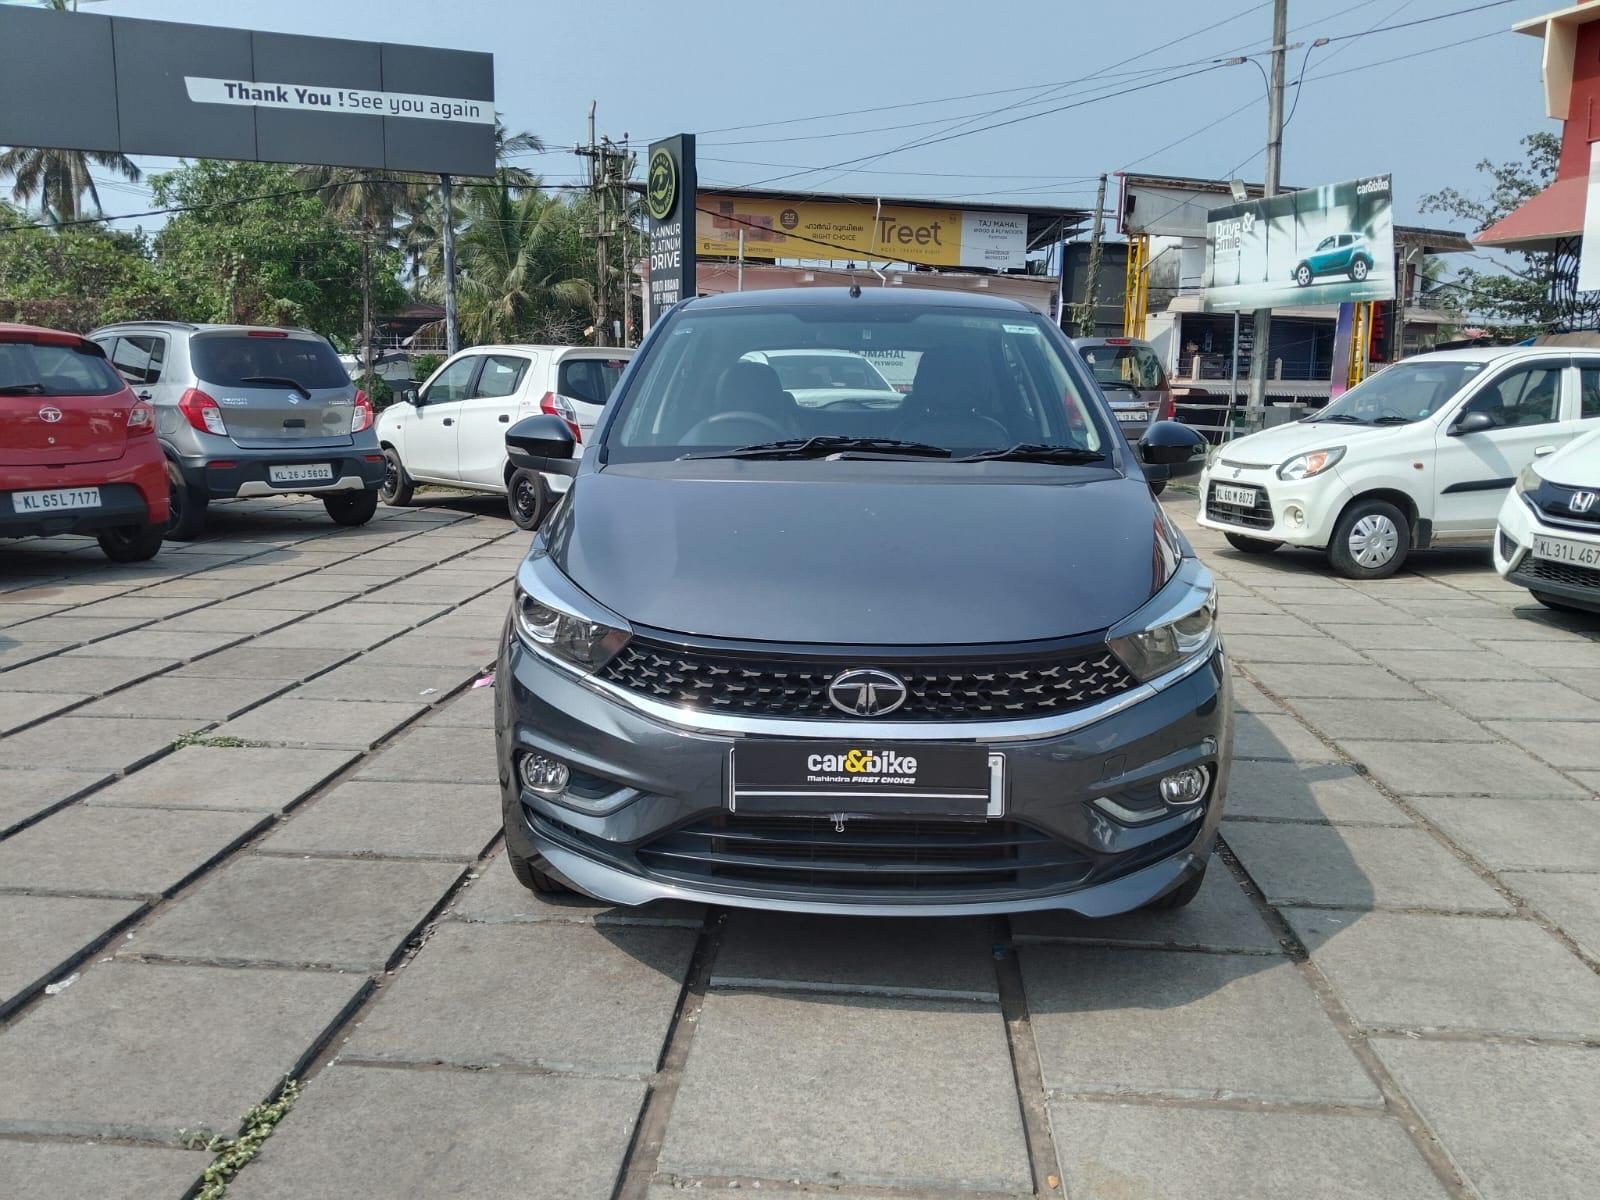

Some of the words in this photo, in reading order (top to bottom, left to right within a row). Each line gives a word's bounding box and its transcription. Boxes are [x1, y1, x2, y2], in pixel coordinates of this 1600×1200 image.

[224, 82, 288, 102] Thank
[294, 88, 331, 106] You
[349, 92, 382, 109] See
[389, 99, 423, 114] you
[430, 101, 480, 118] again
[1357, 179, 1389, 195] car&bike
[873, 216, 942, 246] Treet
[978, 219, 992, 227] TAJ
[994, 220, 1018, 228] MAHAL
[1216, 221, 1240, 237] Drive
[651, 238, 680, 253] PLATINUM
[1215, 235, 1240, 253] Smile
[651, 251, 680, 270] DRIVE
[275, 471, 286, 479] KL
[289, 471, 299, 479] 26
[307, 469, 329, 478] 5602
[23, 495, 40, 509] KL
[1540, 541, 1552, 556] KL
[1554, 544, 1567, 559] 31
[1570, 546, 1575, 560] L
[808, 749, 917, 775] car&bike
[807, 775, 850, 783] Mahindra
